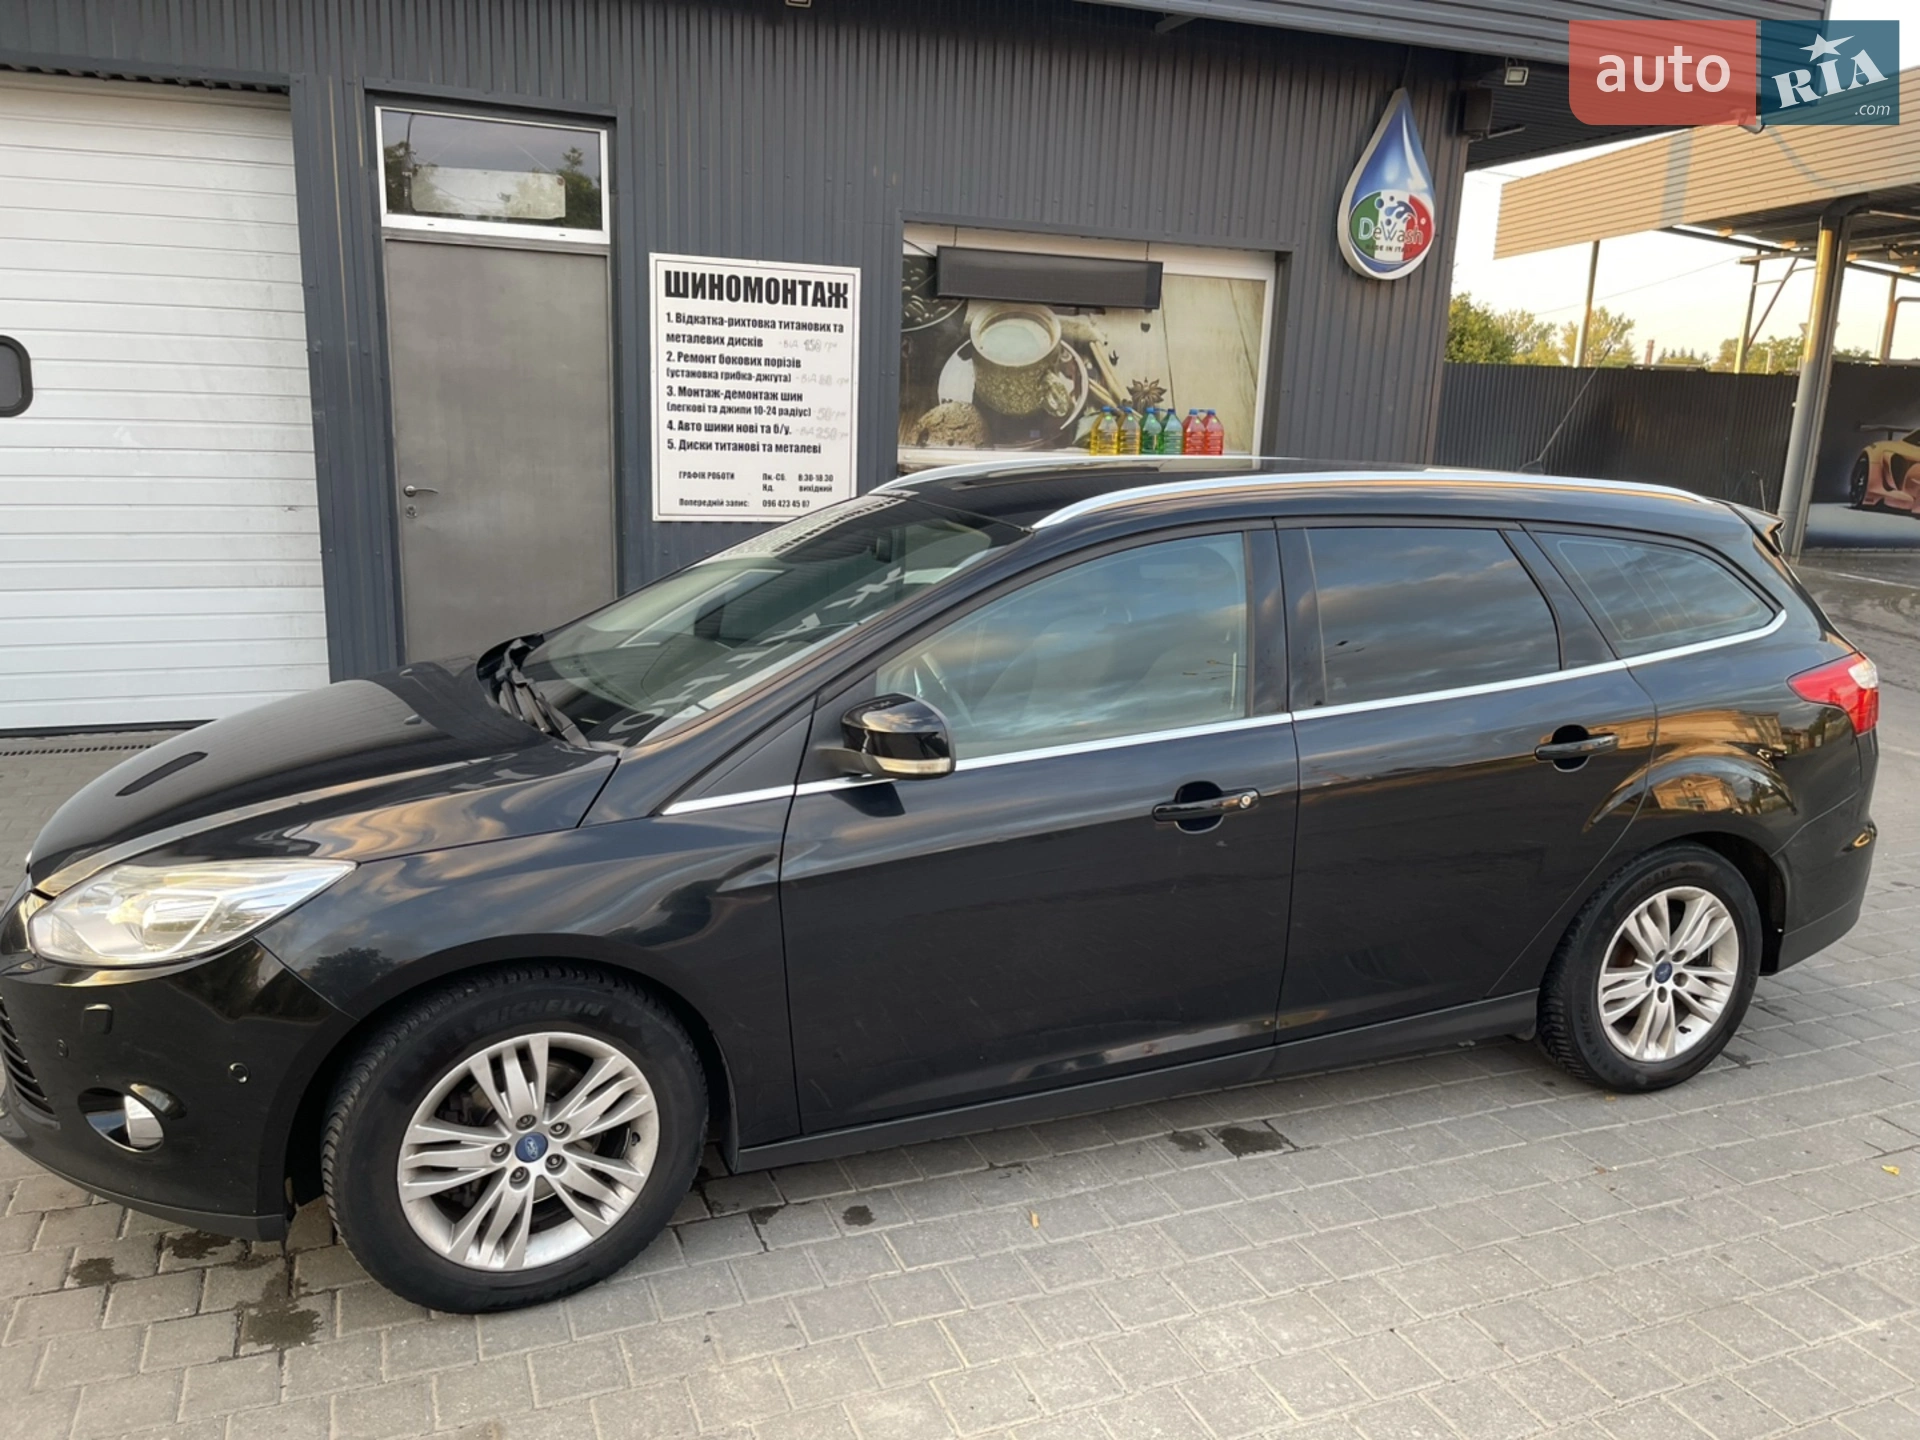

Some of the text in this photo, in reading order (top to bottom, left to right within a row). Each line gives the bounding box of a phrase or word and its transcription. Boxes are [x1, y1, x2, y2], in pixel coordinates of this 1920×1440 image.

[1358, 216, 1424, 246] DeWash
[664, 270, 849, 309] ШИНОМОНТАЖ
[666, 312, 844, 333] 1. Відкатка-рихтовка титанових та
[666, 333, 763, 348] металевих дисків
[666, 350, 802, 369] 2. Ремонт бокових порізів
[666, 367, 792, 383] (установка грибка-джгута)
[666, 385, 803, 402] 3. Монтаж-демонтаж шин
[666, 401, 812, 418] (легкові та джипи 10-24 радіус)
[666, 420, 792, 436] 4. Авто шини нові та б/у.
[667, 438, 822, 454] 5. Диски титанові та металеві
[678, 470, 735, 481] ГРАФІК РОБОТИ
[798, 484, 833, 493] вихідний
[678, 498, 725, 508] Попередній
[725, 500, 750, 508] запис:
[762, 500, 777, 508] 096
[777, 500, 791, 508] 423
[792, 500, 801, 508] 45
